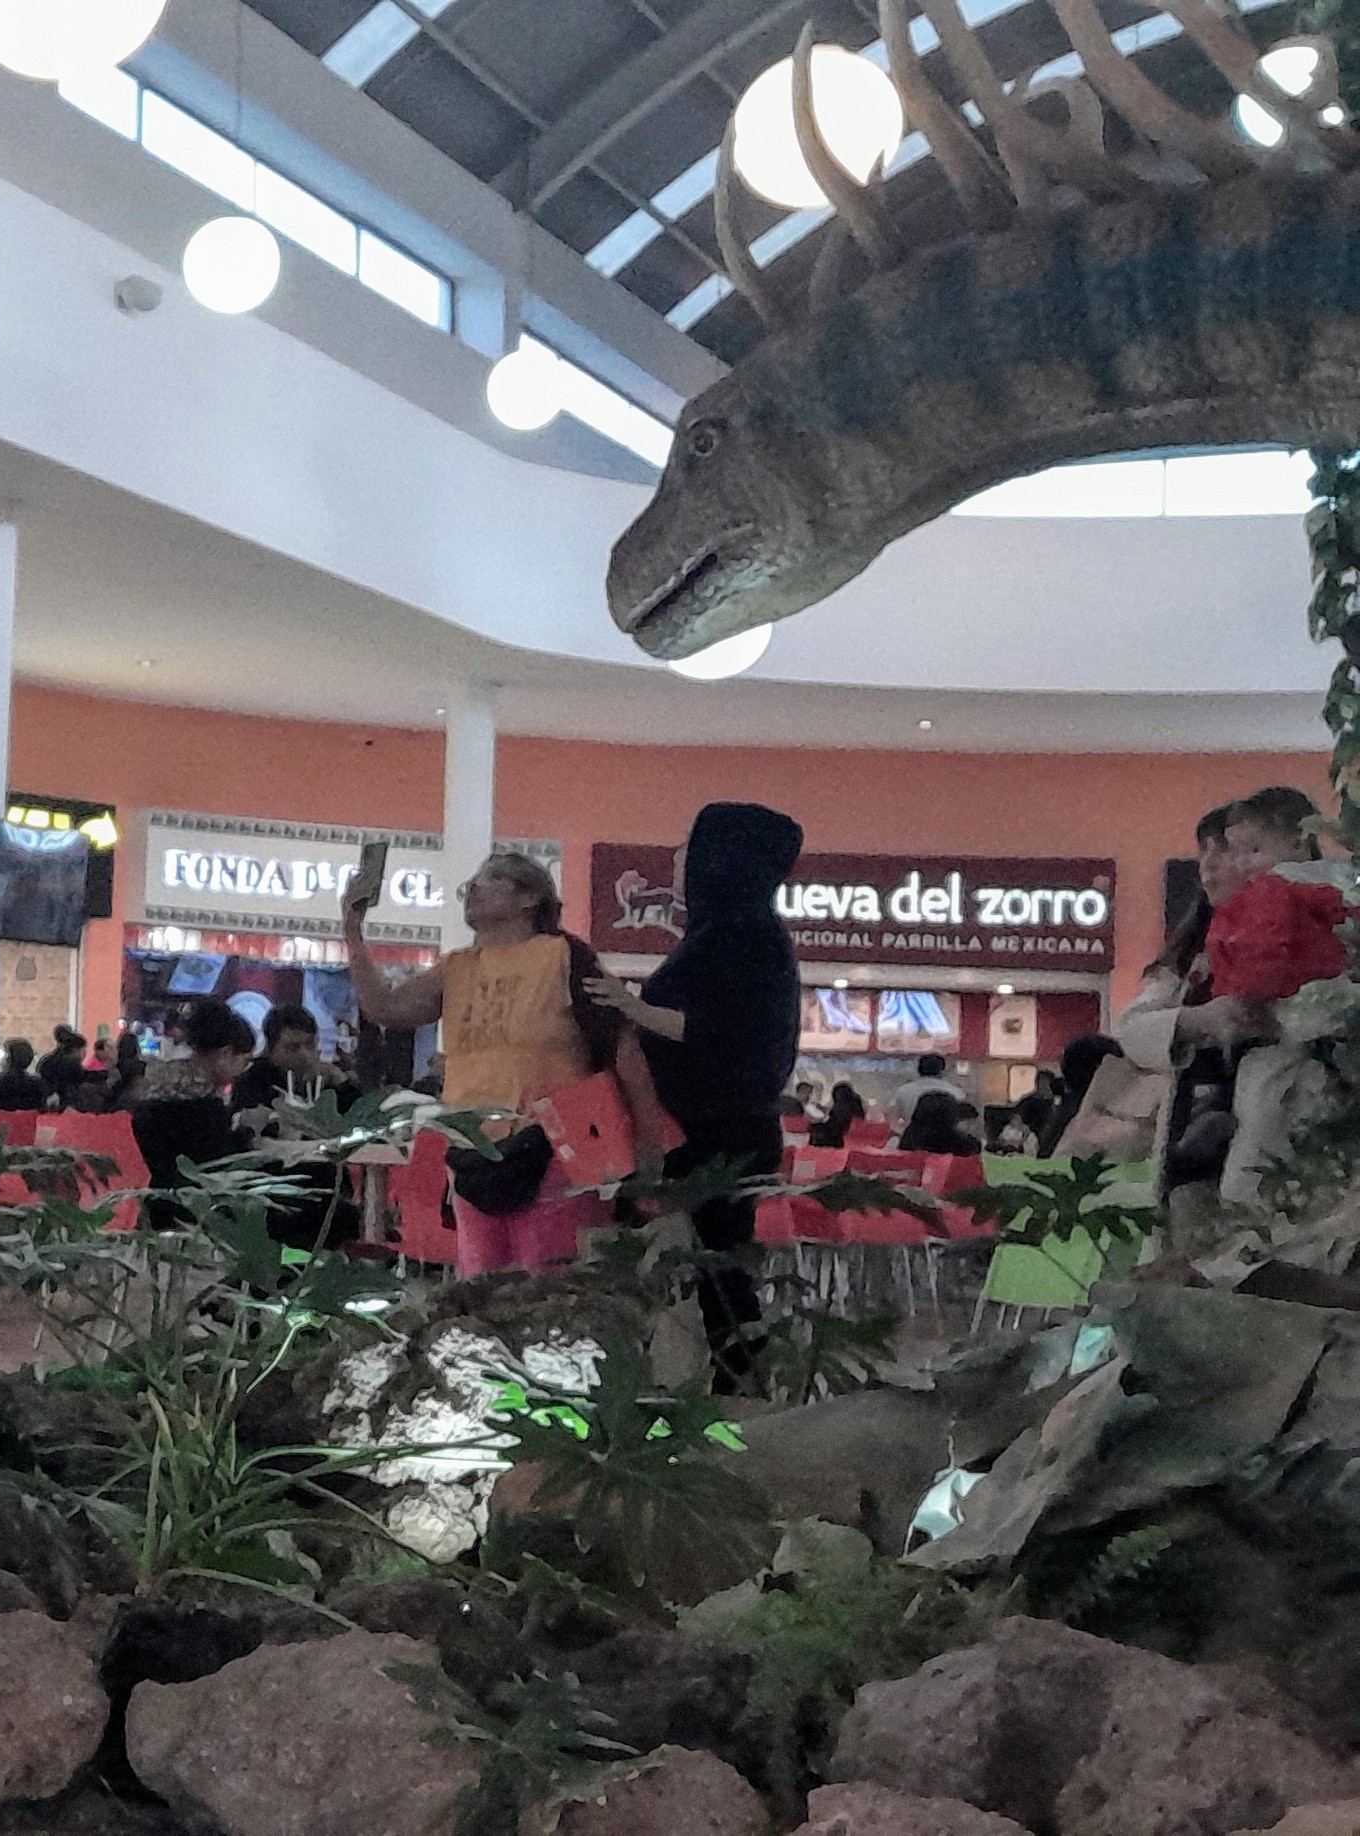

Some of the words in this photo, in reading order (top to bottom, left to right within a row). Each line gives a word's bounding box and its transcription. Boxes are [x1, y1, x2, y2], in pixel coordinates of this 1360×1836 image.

[162, 847, 290, 896] FONDA
[389, 868, 444, 908] CL
[775, 882, 880, 922] ueva
[890, 869, 964, 924] del
[976, 887, 1107, 926] zorro
[789, 929, 874, 949] ICIONAL
[881, 931, 983, 951] PARRILLA
[991, 935, 1105, 955] MEXICANA
